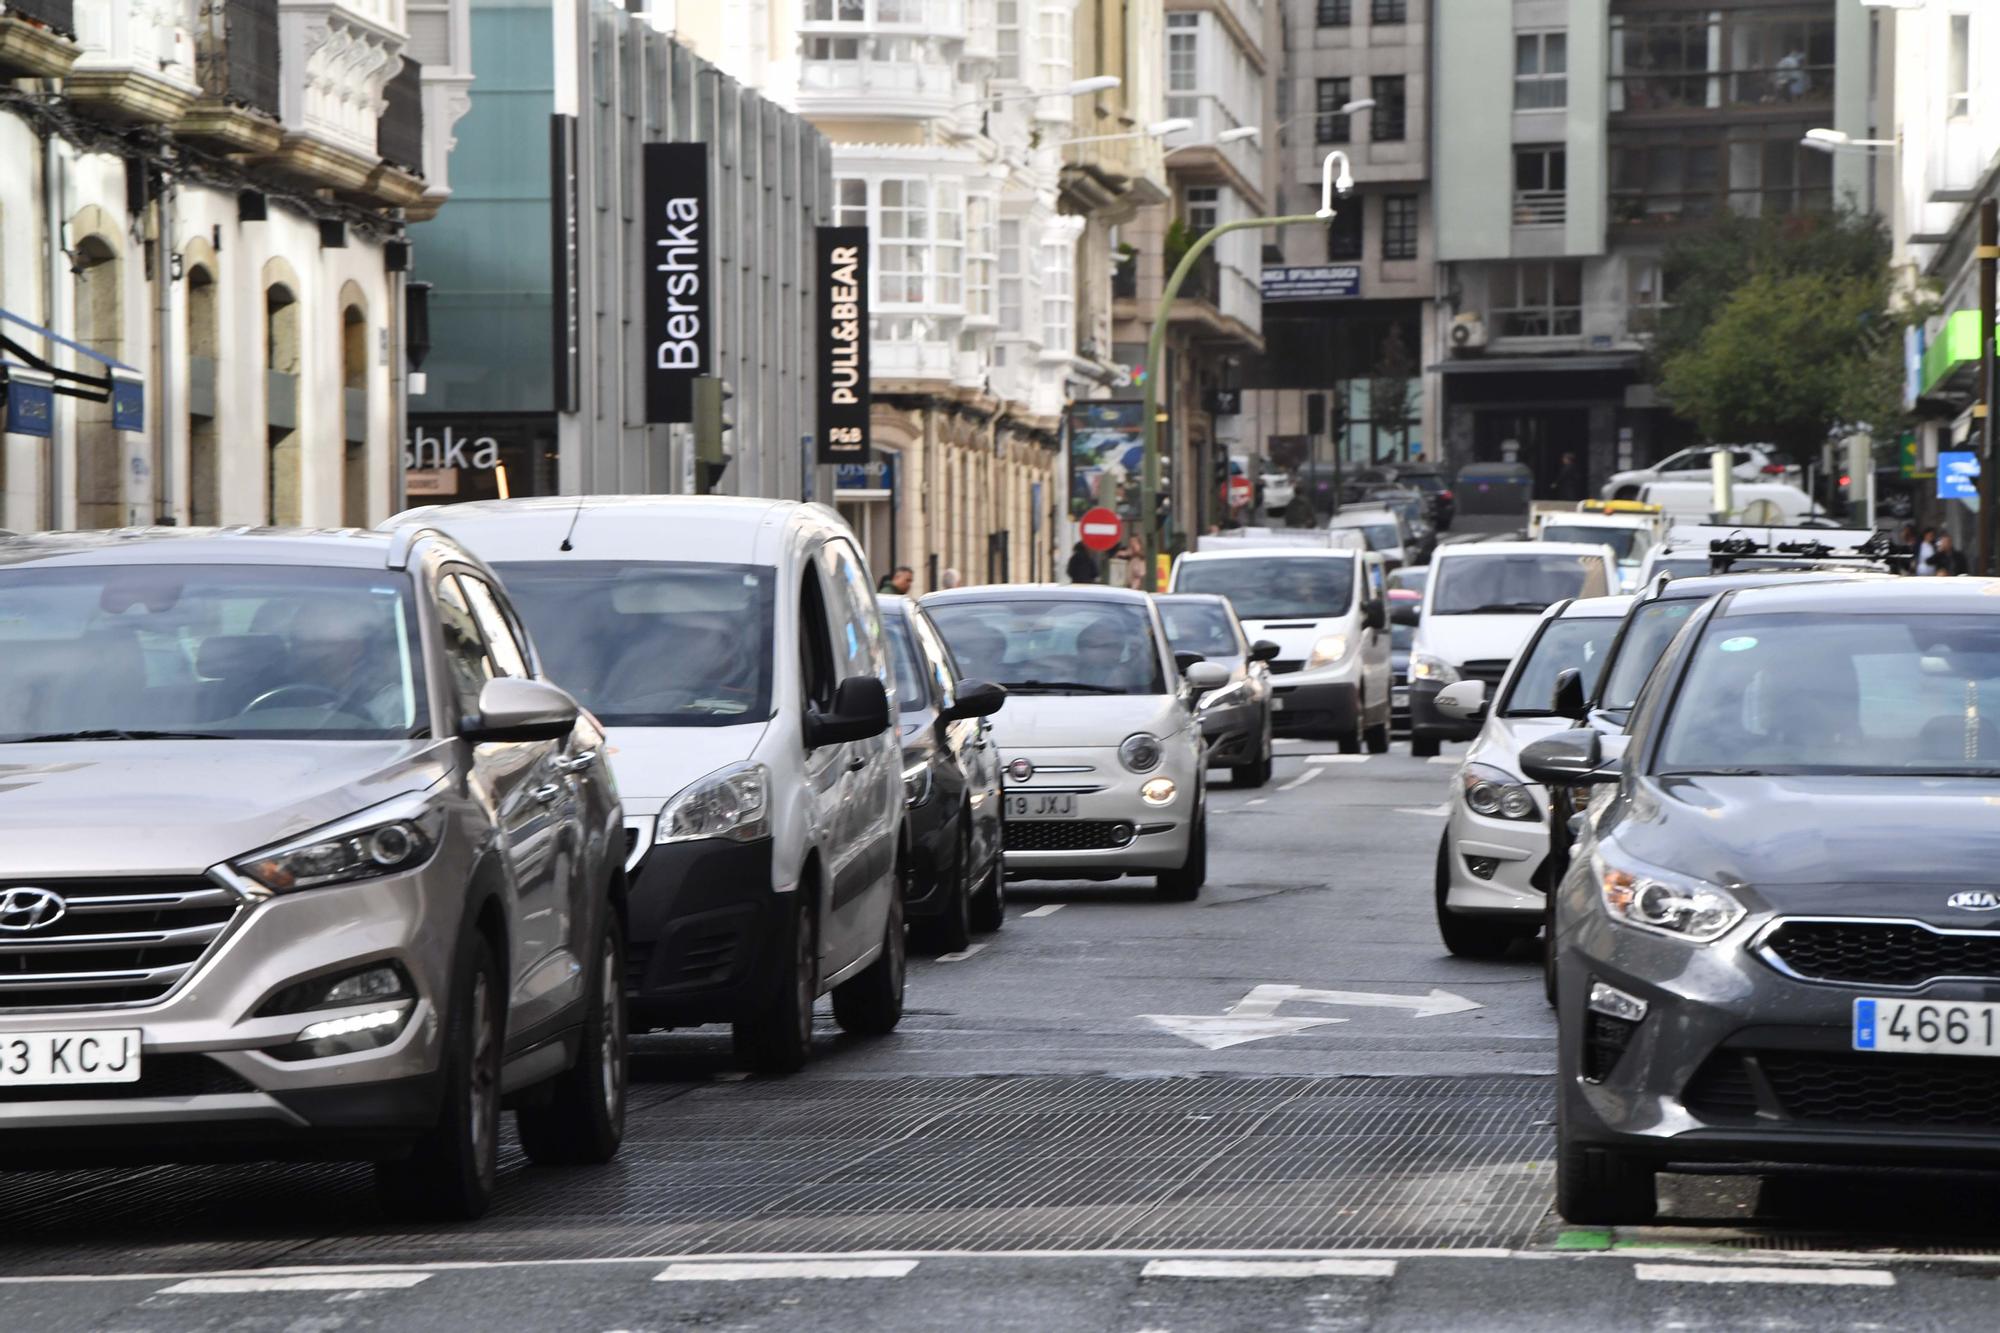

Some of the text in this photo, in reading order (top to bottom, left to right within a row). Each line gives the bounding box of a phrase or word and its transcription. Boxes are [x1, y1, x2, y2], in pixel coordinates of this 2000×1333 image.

[656, 197, 700, 369] Bershka
[831, 247, 859, 405] PULL&BEAR
[1035, 796, 1071, 814] JXJ
[1957, 892, 1998, 906] KIA
[1888, 1004, 1994, 1047] 4661
[0, 1036, 128, 1075] 3 KCJ
